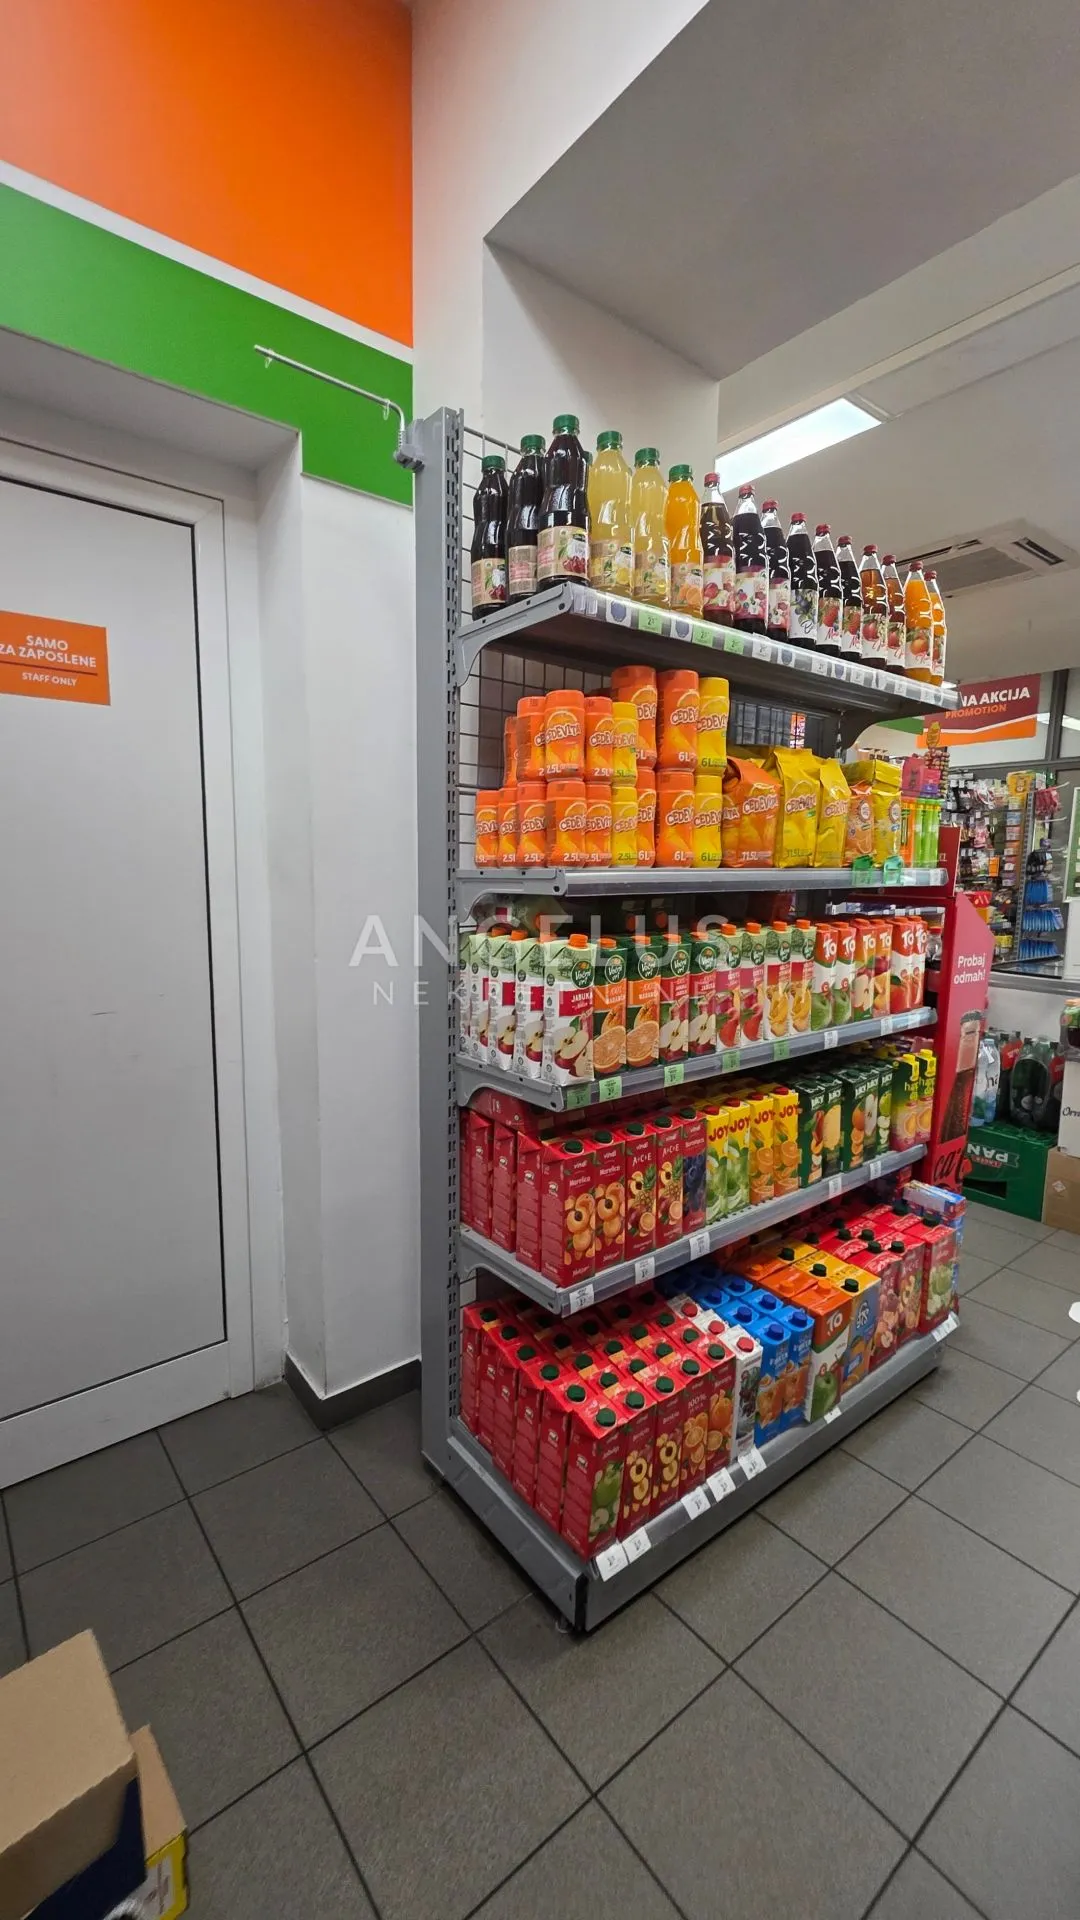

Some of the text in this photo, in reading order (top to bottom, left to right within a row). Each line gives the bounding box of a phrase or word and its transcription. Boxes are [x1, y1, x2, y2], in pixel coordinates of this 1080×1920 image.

[26, 635, 68, 651] SAMO
[0, 643, 97, 668] ZA ZAPOSLENE
[22, 672, 78, 687] STAFF ONLY
[979, 686, 1031, 705] AKCIJA
[945, 703, 1008, 719] PROMOTION
[957, 952, 986, 968] Probaj
[953, 969, 986, 984] odmah!
[571, 991, 593, 1003] JABUKA
[754, 1109, 775, 1125] JOY
[779, 1103, 800, 1119] JOY
[729, 1115, 751, 1133] JOY
[709, 1124, 729, 1142] JOY
[967, 1143, 1009, 1163] PAN
